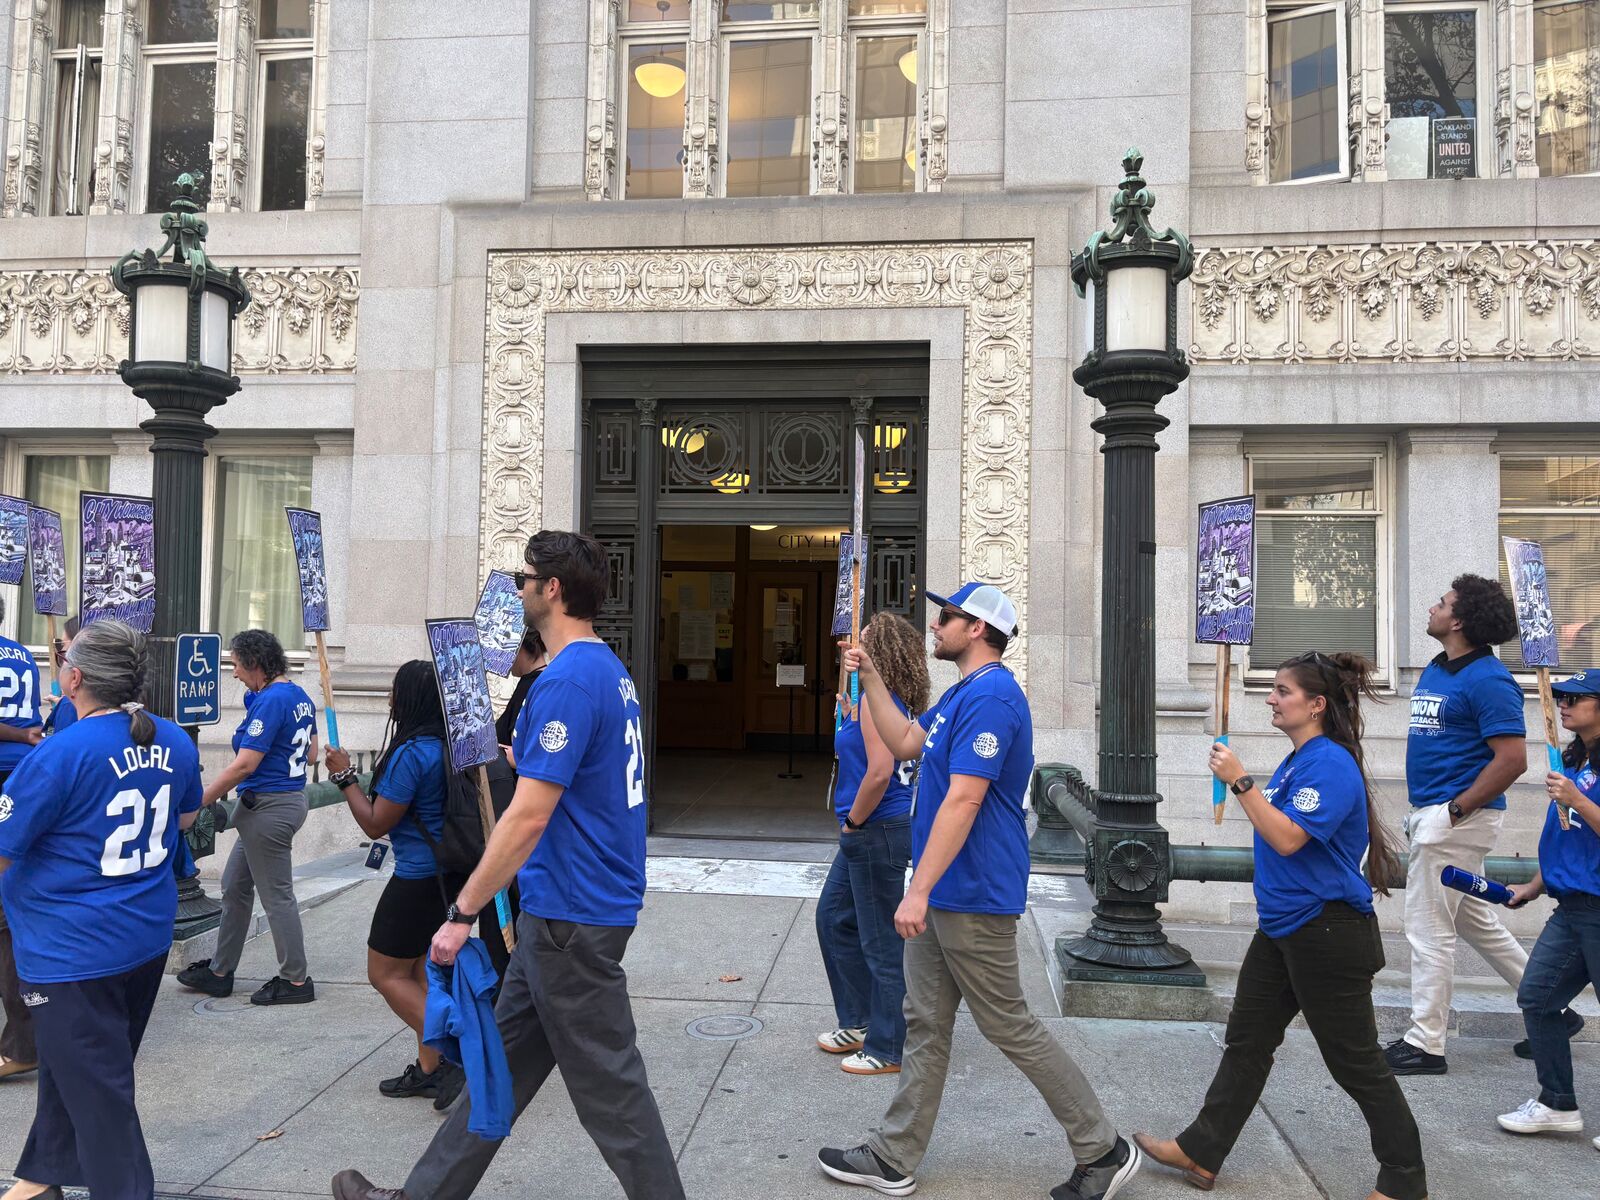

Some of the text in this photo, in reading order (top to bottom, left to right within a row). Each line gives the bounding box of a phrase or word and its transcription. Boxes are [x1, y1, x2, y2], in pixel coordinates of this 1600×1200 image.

[1439, 142, 1471, 156] UNITED
[1440, 159, 1471, 167] AGAINST
[778, 535, 814, 549] CITY
[0, 646, 31, 665] OCAL
[0, 666, 33, 719] 21
[180, 680, 215, 698] RAMP
[292, 702, 314, 723] LOCAL
[108, 745, 173, 779] LOCAL
[100, 784, 171, 877] 21
